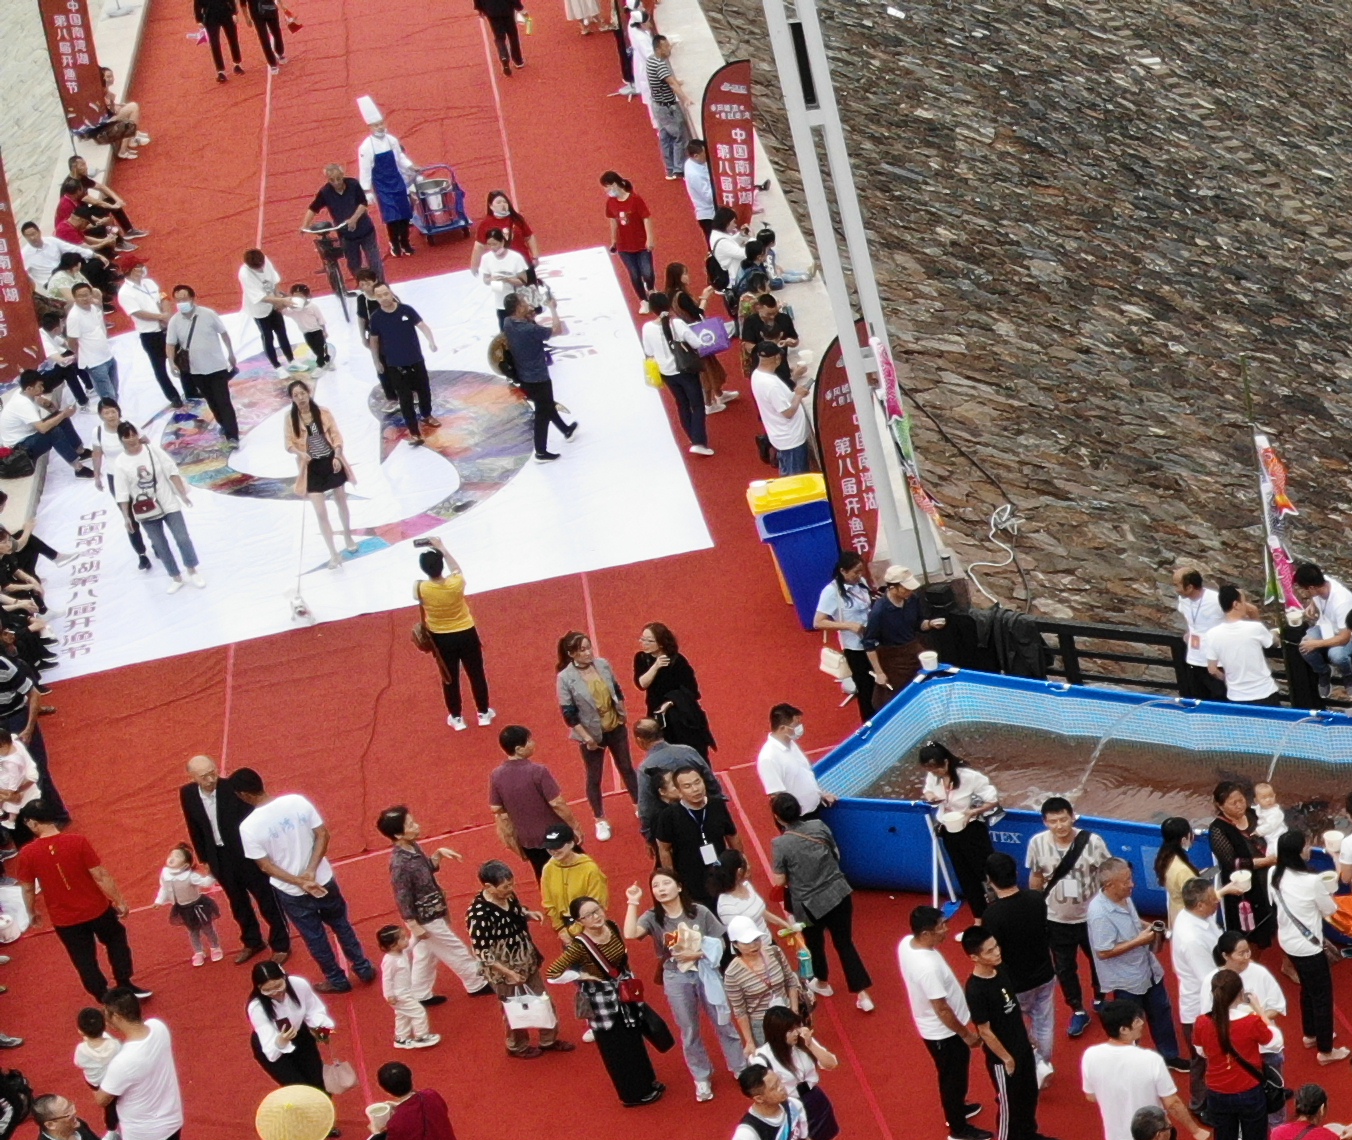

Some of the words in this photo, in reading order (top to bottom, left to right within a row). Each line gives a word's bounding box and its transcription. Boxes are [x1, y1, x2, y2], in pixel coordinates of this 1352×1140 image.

[716, 144, 735, 207] 第八届开
[731, 128, 753, 205] 中国南湾湖
[833, 437, 869, 555] 第八届开渔节
[61, 509, 107, 659] 中国南湾湖第八届开渔节
[989, 830, 1023, 844] TEX
